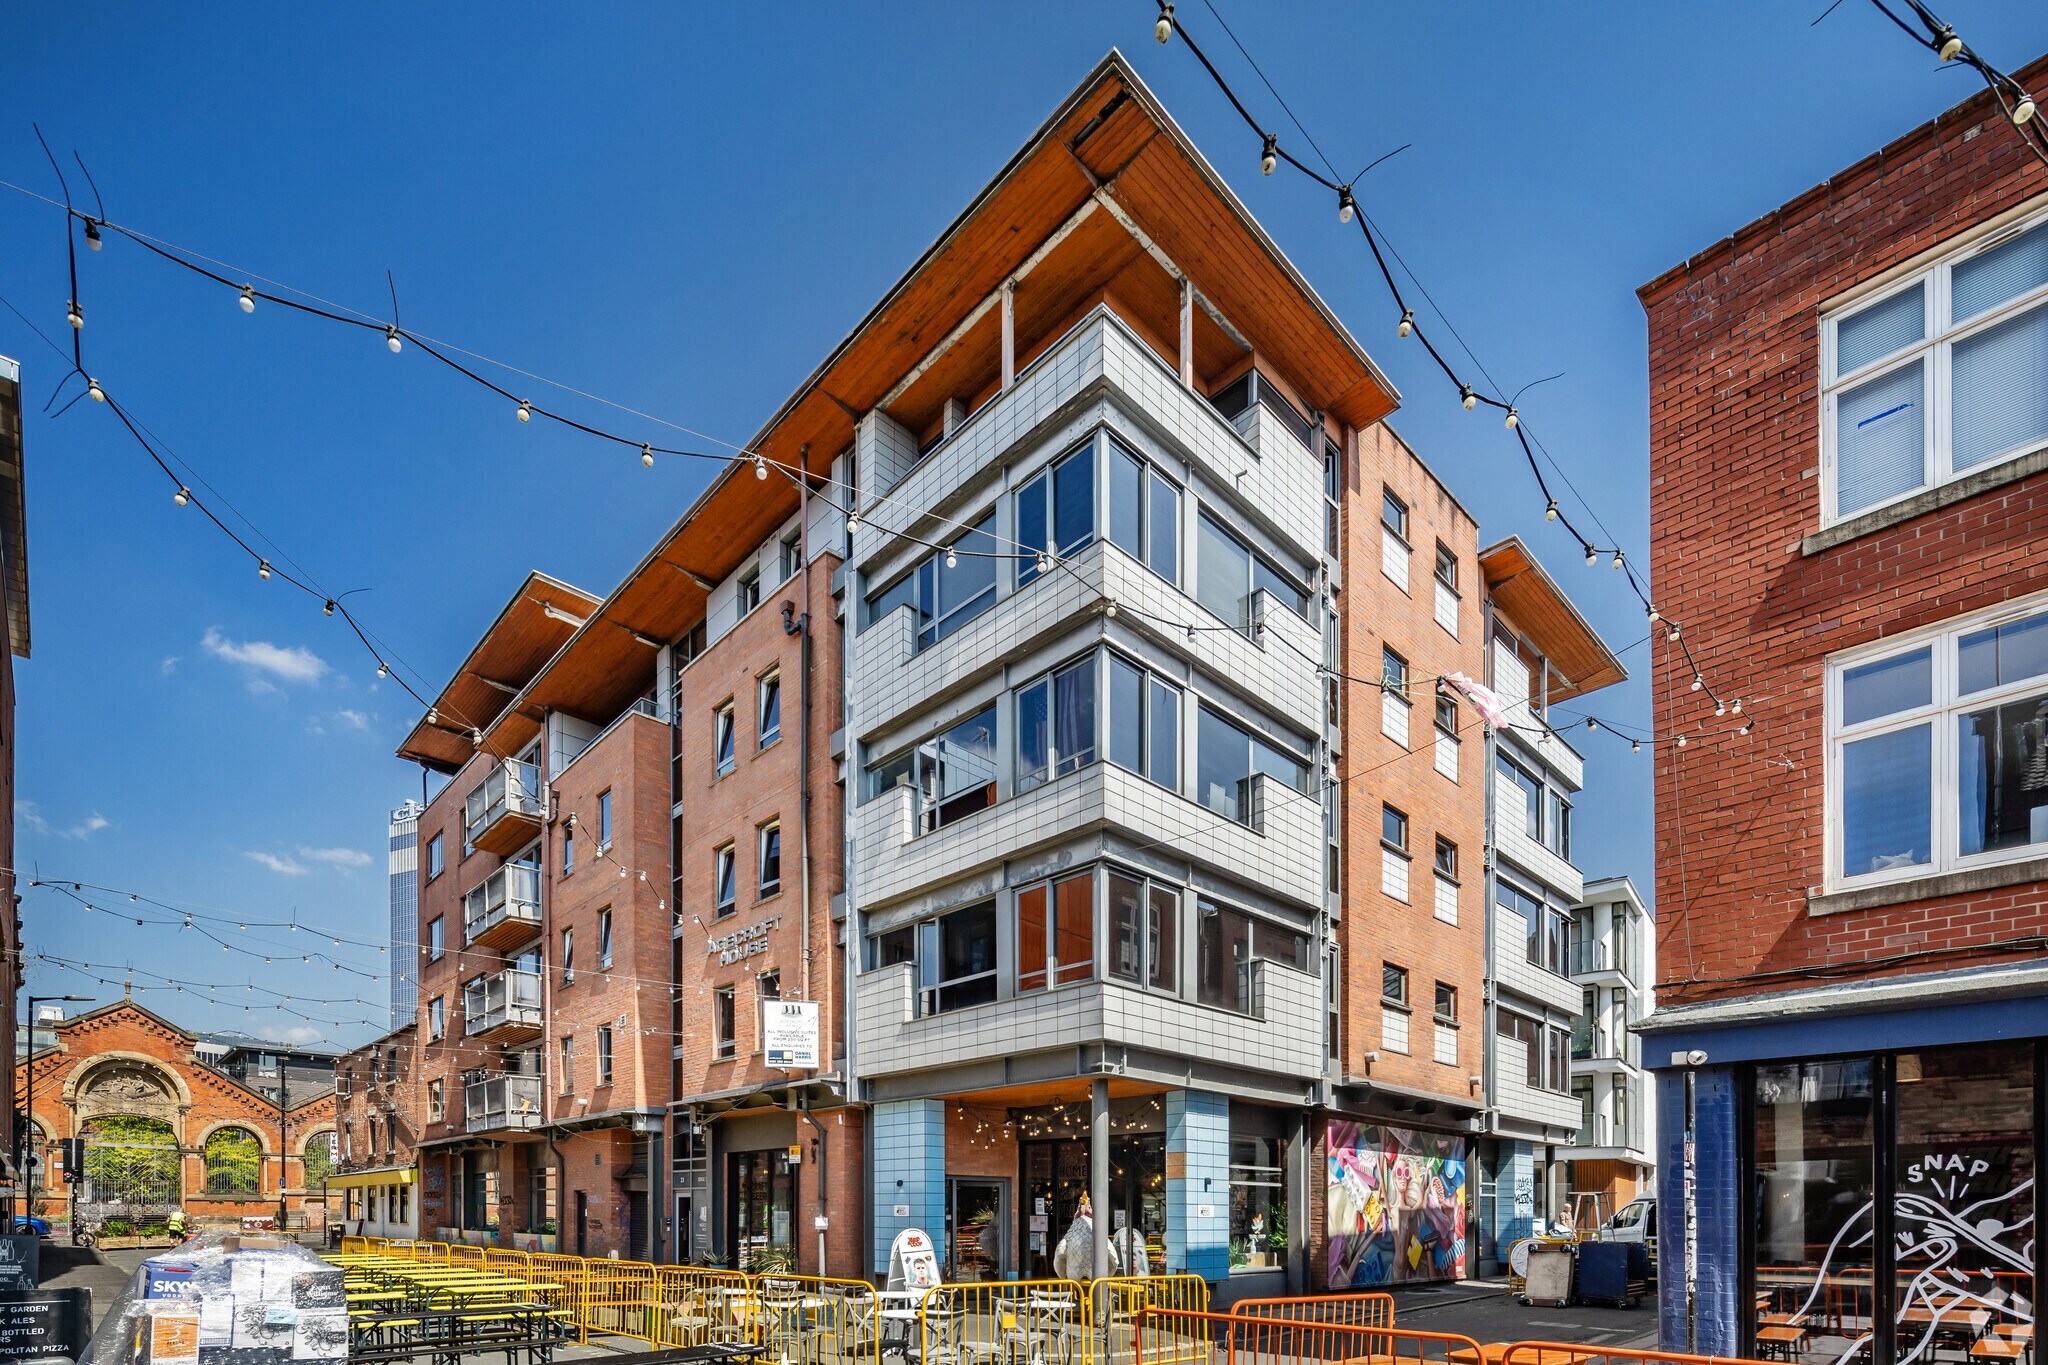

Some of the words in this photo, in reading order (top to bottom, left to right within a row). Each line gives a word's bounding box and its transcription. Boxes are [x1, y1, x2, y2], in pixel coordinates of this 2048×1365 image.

[707, 914, 783, 956] AGECROFT
[719, 936, 768, 967] HOUSE
[1907, 1153, 1990, 1183] SNAP
[10, 1305, 49, 1314] GARDEN
[11, 1316, 36, 1325] ALES
[1, 1327, 45, 1337] BOTTLED
[42, 1344, 70, 1352] PIZZA
